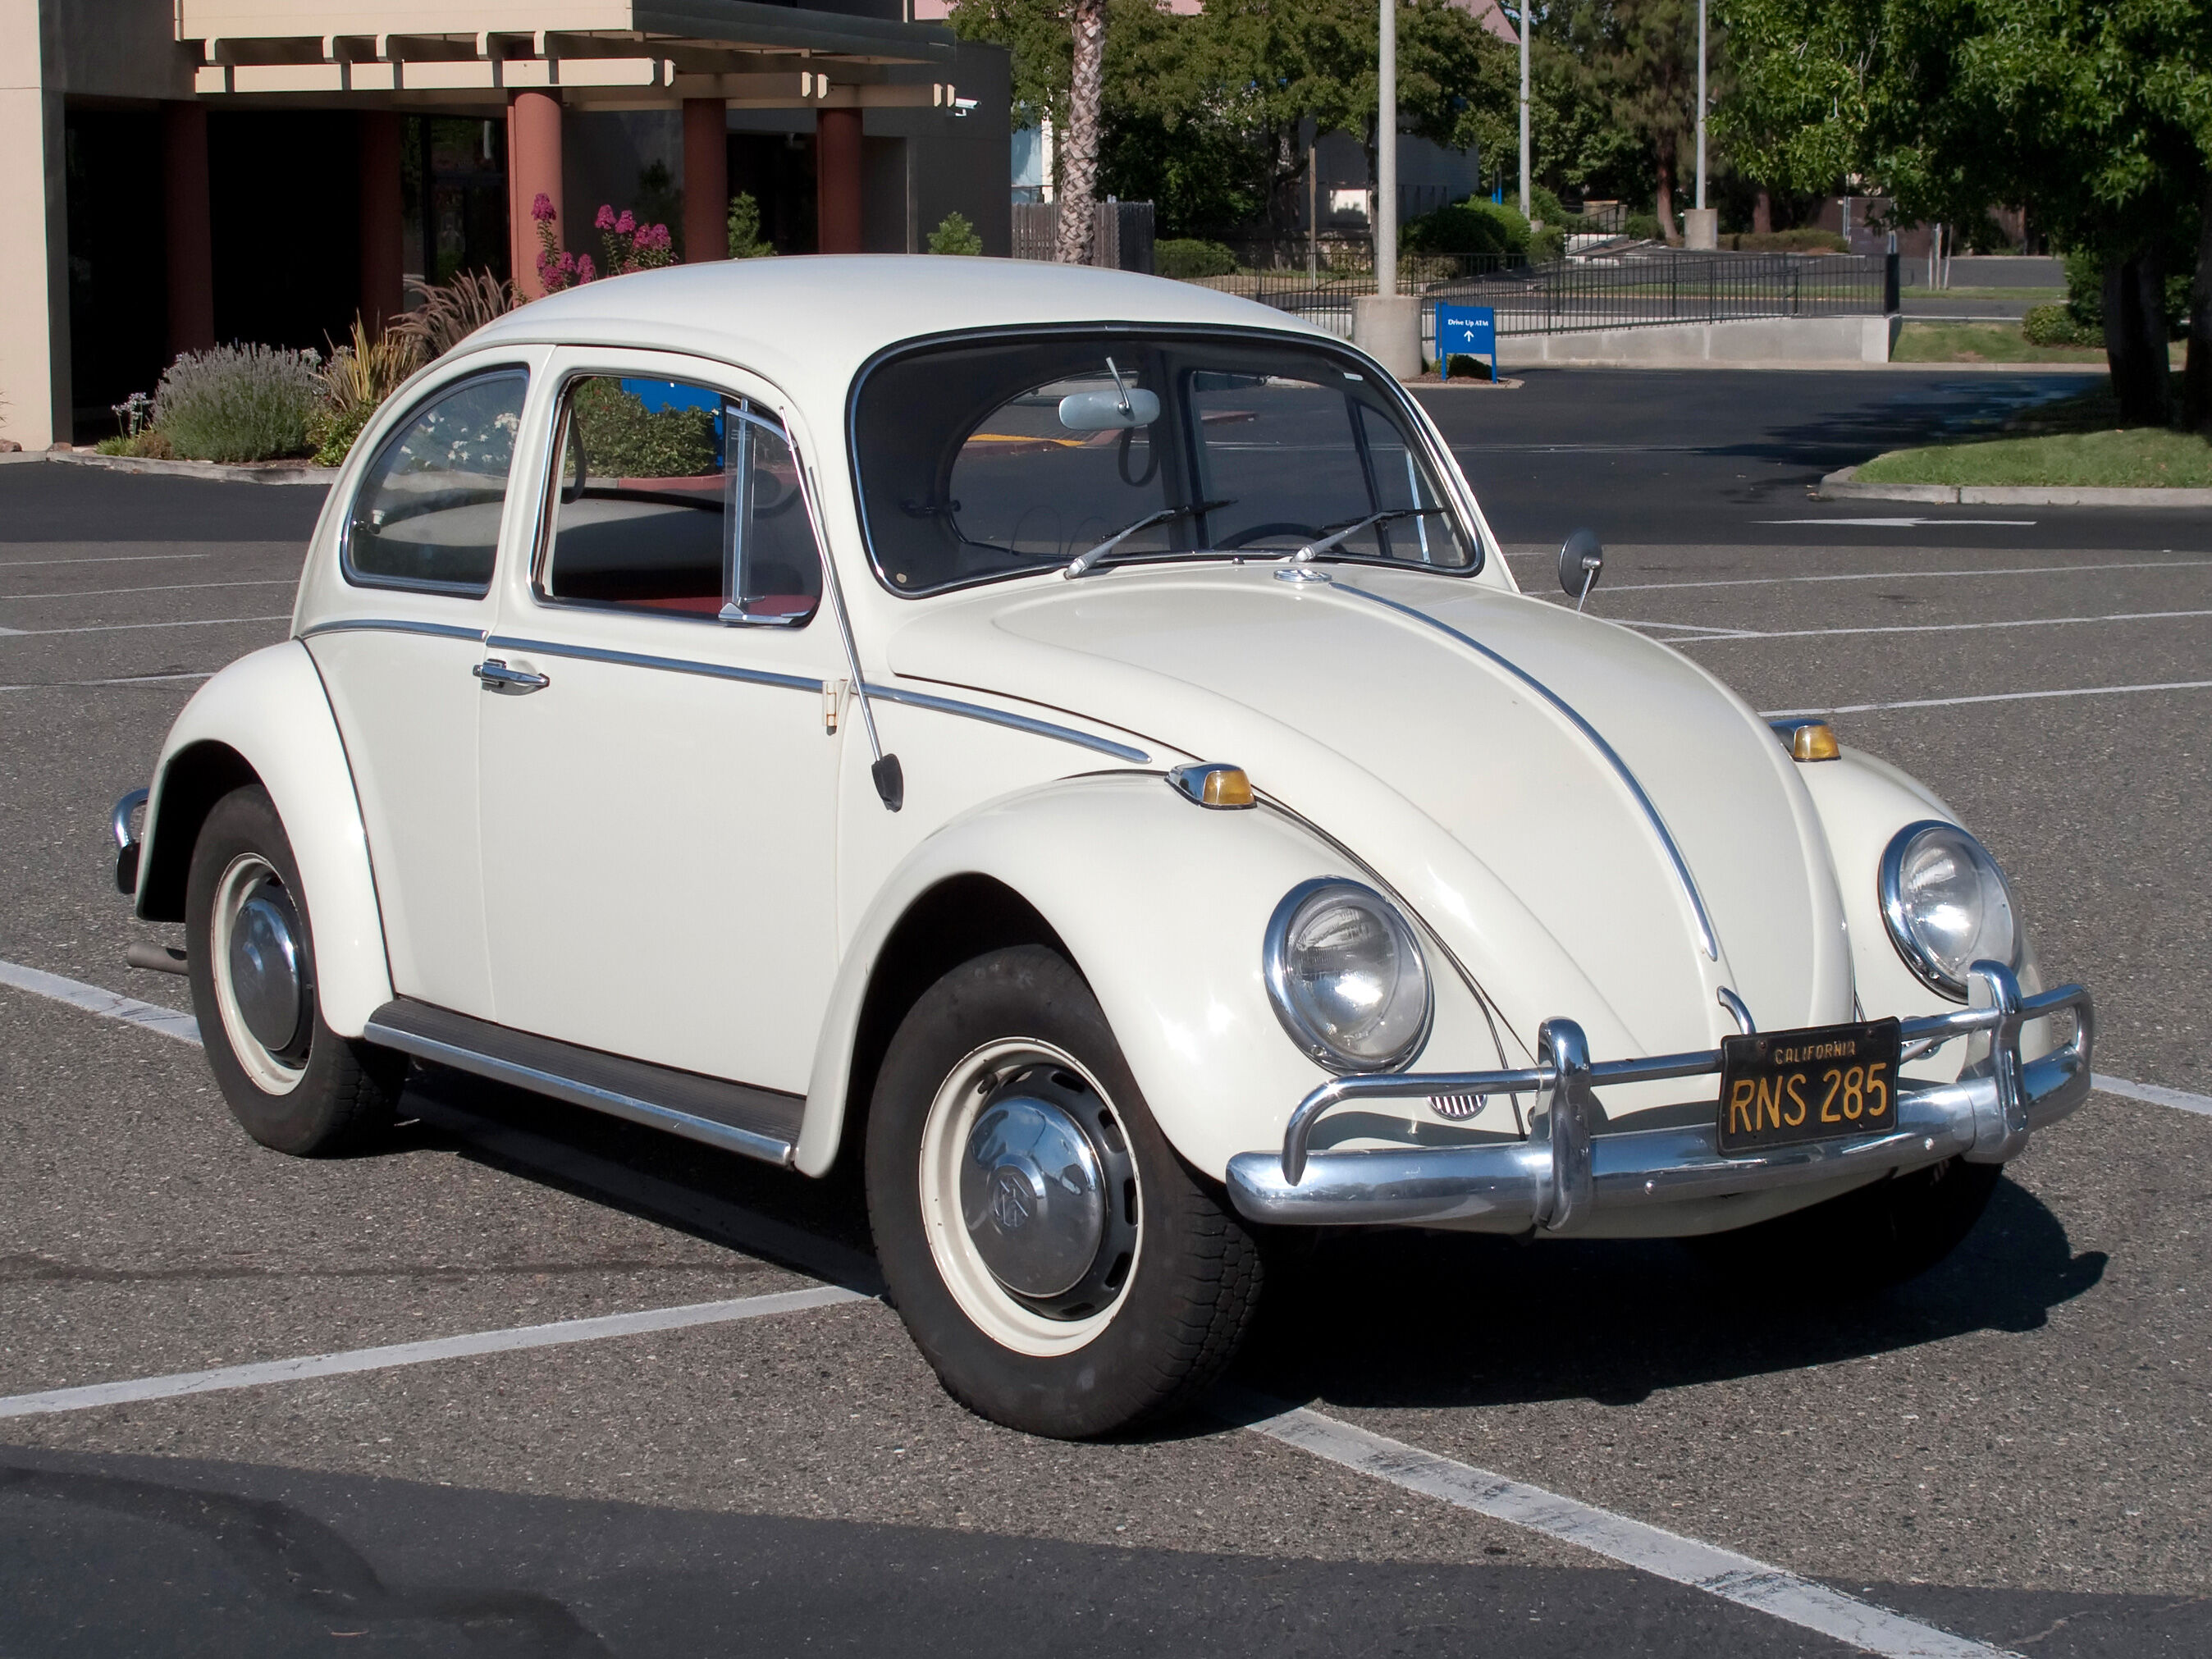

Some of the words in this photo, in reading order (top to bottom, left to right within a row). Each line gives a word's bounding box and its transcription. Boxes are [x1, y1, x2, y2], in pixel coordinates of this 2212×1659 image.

[1465, 319, 1474, 327] Up
[1775, 1040, 1857, 1065] CALIFORNIA
[1730, 1073, 1807, 1134] RNS
[1821, 1063, 1887, 1123] 285
